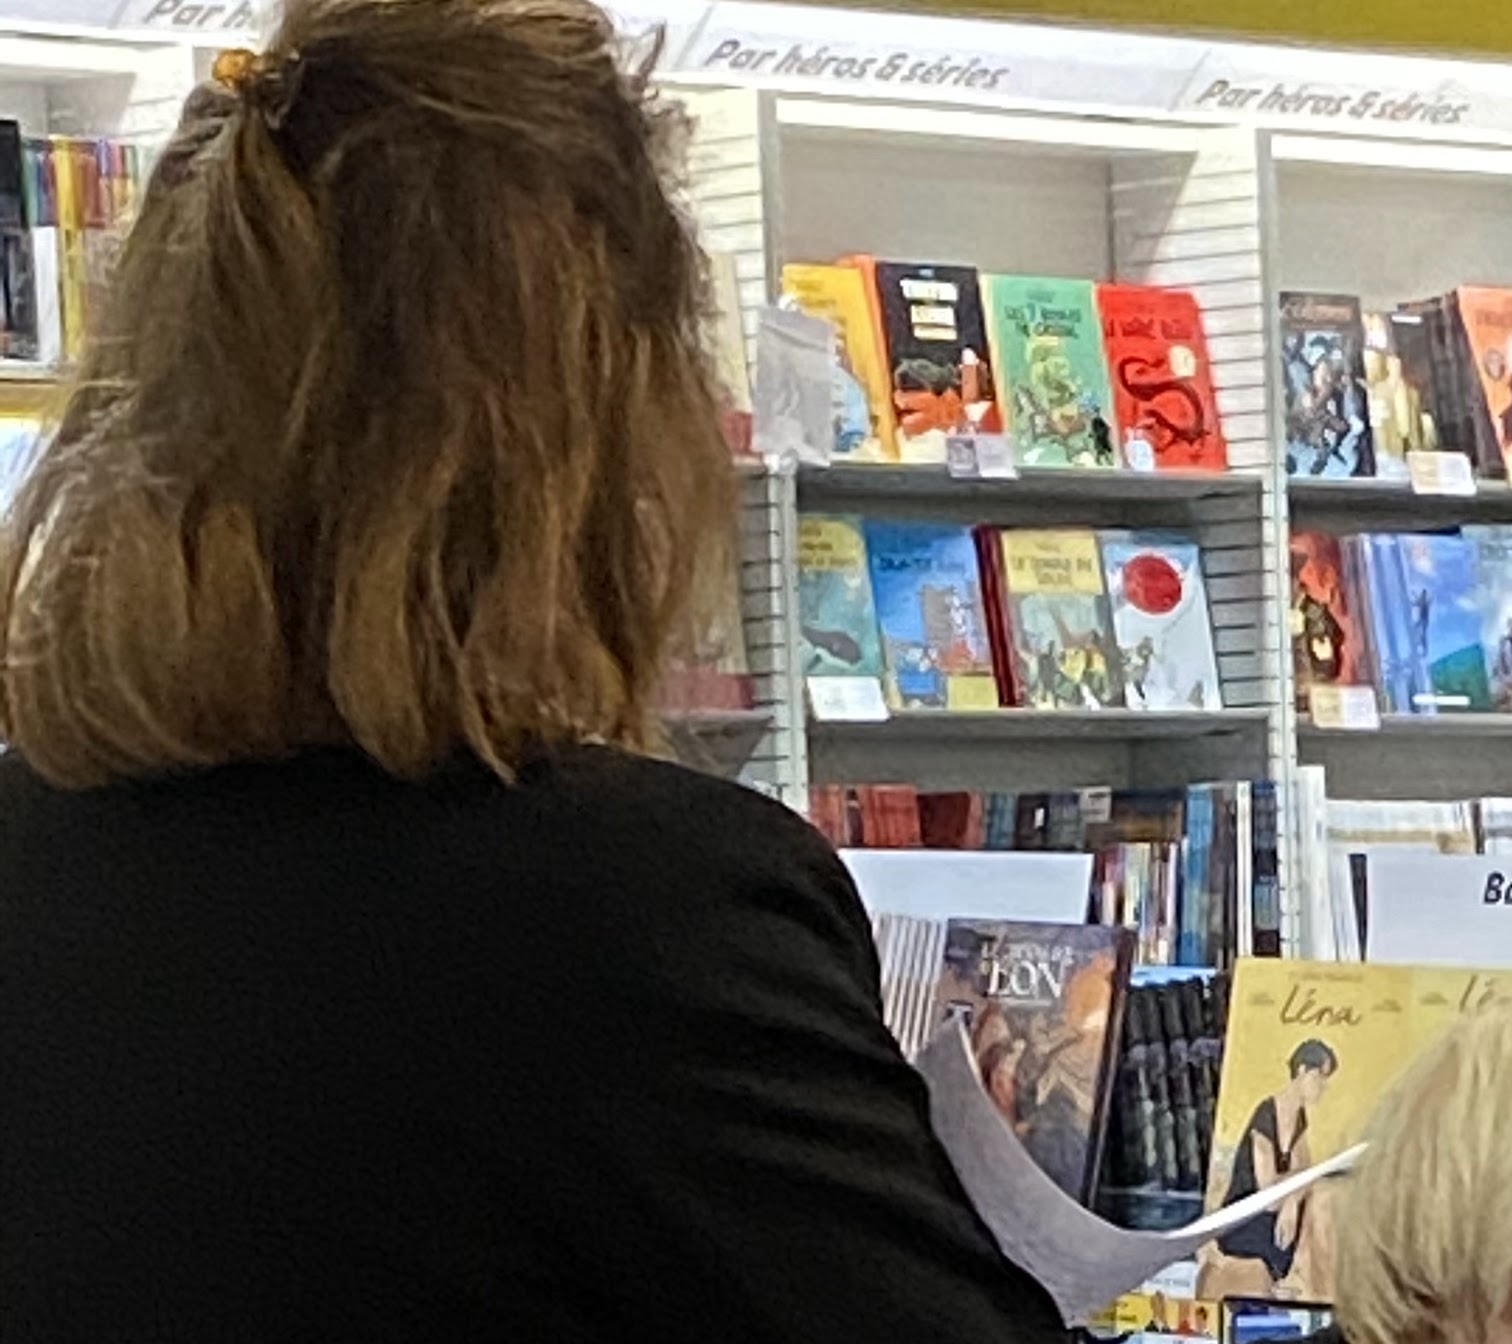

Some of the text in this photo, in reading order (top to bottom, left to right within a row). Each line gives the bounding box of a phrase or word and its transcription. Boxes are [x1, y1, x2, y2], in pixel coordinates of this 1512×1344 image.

[704, 39, 1010, 90] Par héros & séries
[1197, 79, 1264, 109] Par
[1264, 83, 1349, 119] héros
[1372, 93, 1469, 125] séries
[1280, 984, 1362, 1026] Léna
